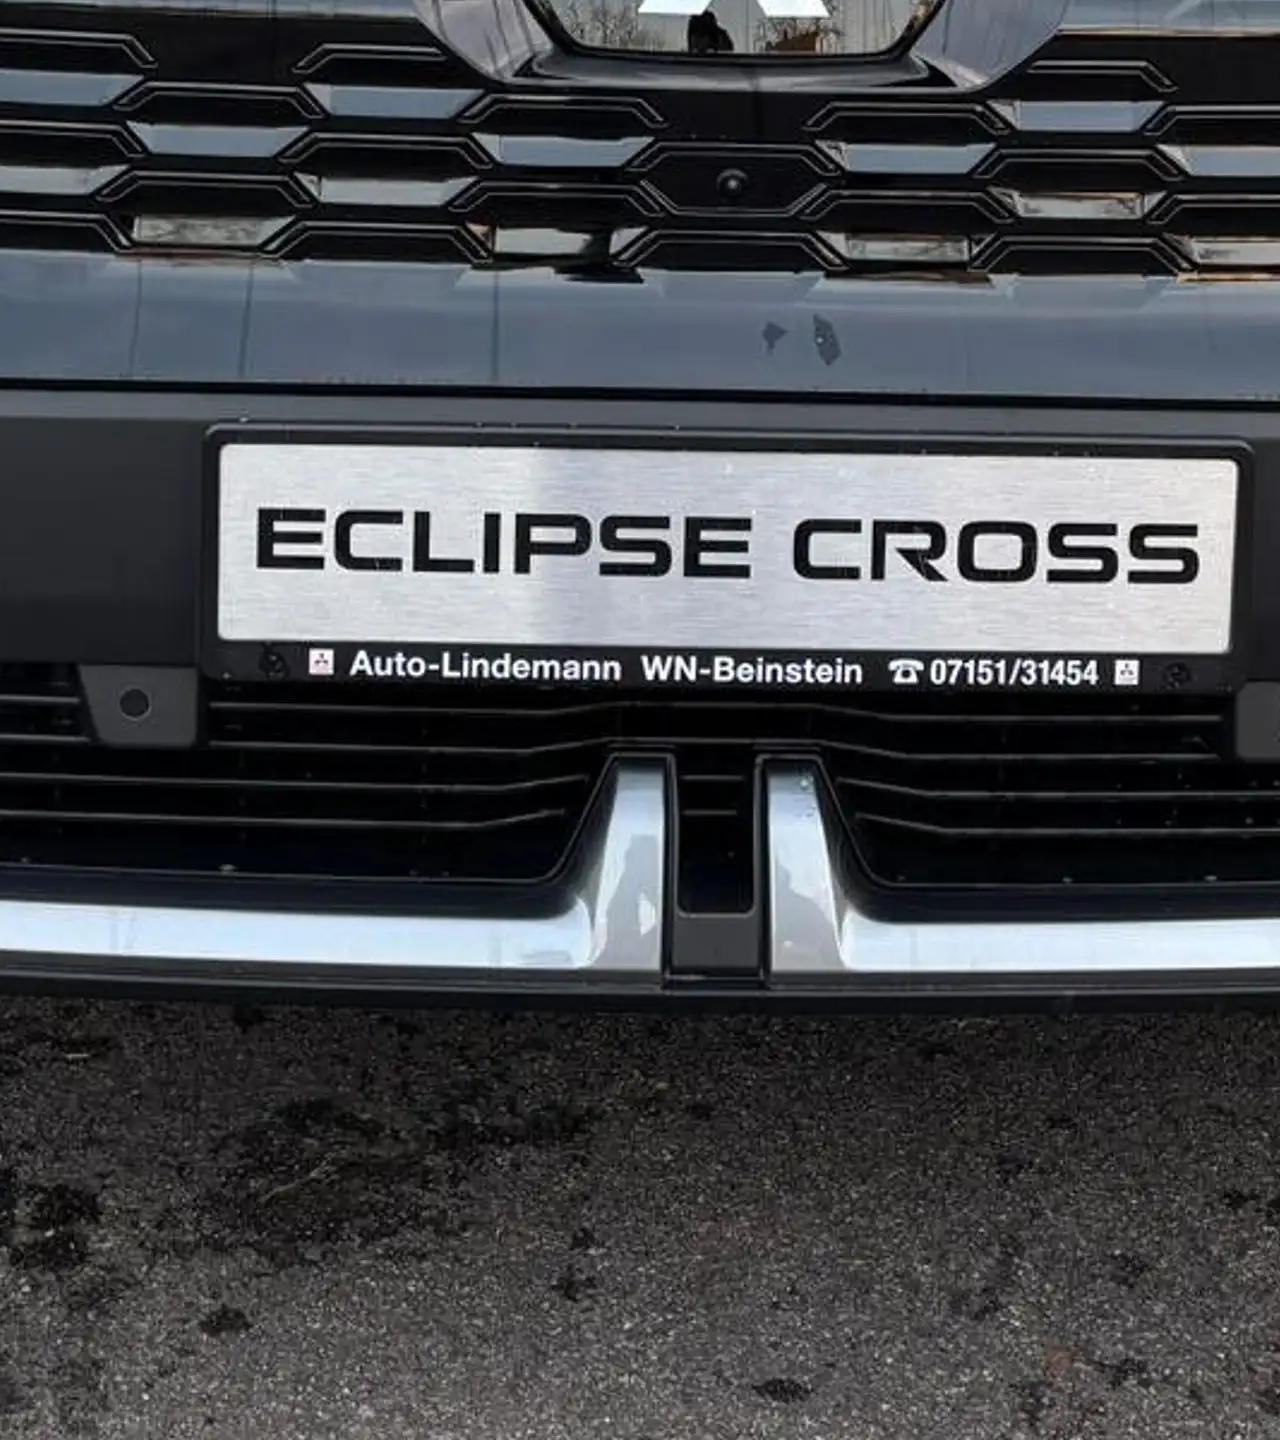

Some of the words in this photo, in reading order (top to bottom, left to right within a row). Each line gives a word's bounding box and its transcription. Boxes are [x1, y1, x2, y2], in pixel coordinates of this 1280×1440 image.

[256, 508, 752, 579] ECLIPSE
[793, 518, 1200, 584] CROSS
[349, 649, 622, 681] Auto-Lindemann
[640, 655, 863, 684] WN-Beinstein
[930, 658, 1099, 686] 07151/31454
